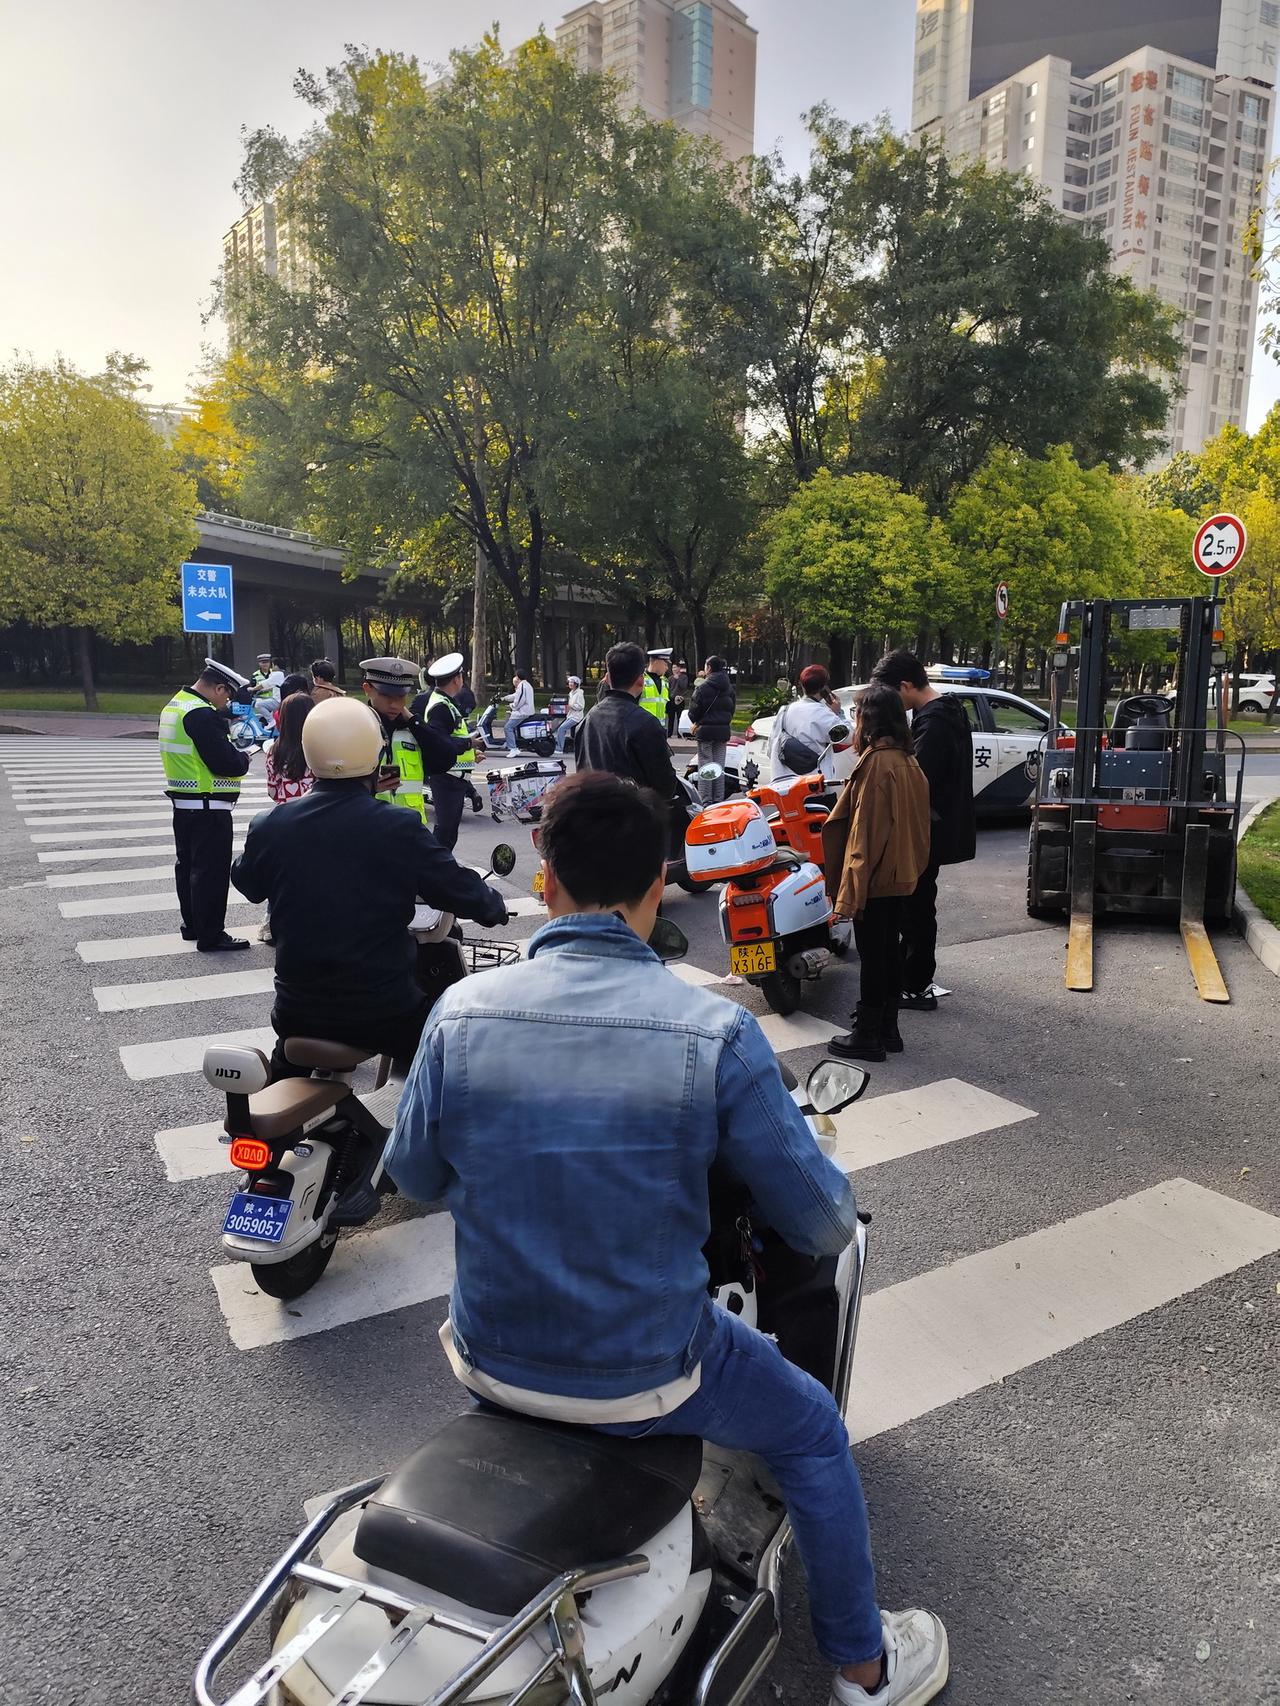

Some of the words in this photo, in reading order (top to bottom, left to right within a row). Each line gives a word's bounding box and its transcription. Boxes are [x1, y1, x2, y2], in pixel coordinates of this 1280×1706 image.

[1128, 104, 1141, 142] FULIN
[1122, 148, 1138, 230] RESTAURANT
[1202, 534, 1236, 557] 2.5m
[197, 569, 217, 582] 交警
[188, 585, 228, 600] 未央大队
[733, 956, 772, 974] X316F
[227, 1214, 284, 1237] 3059057
